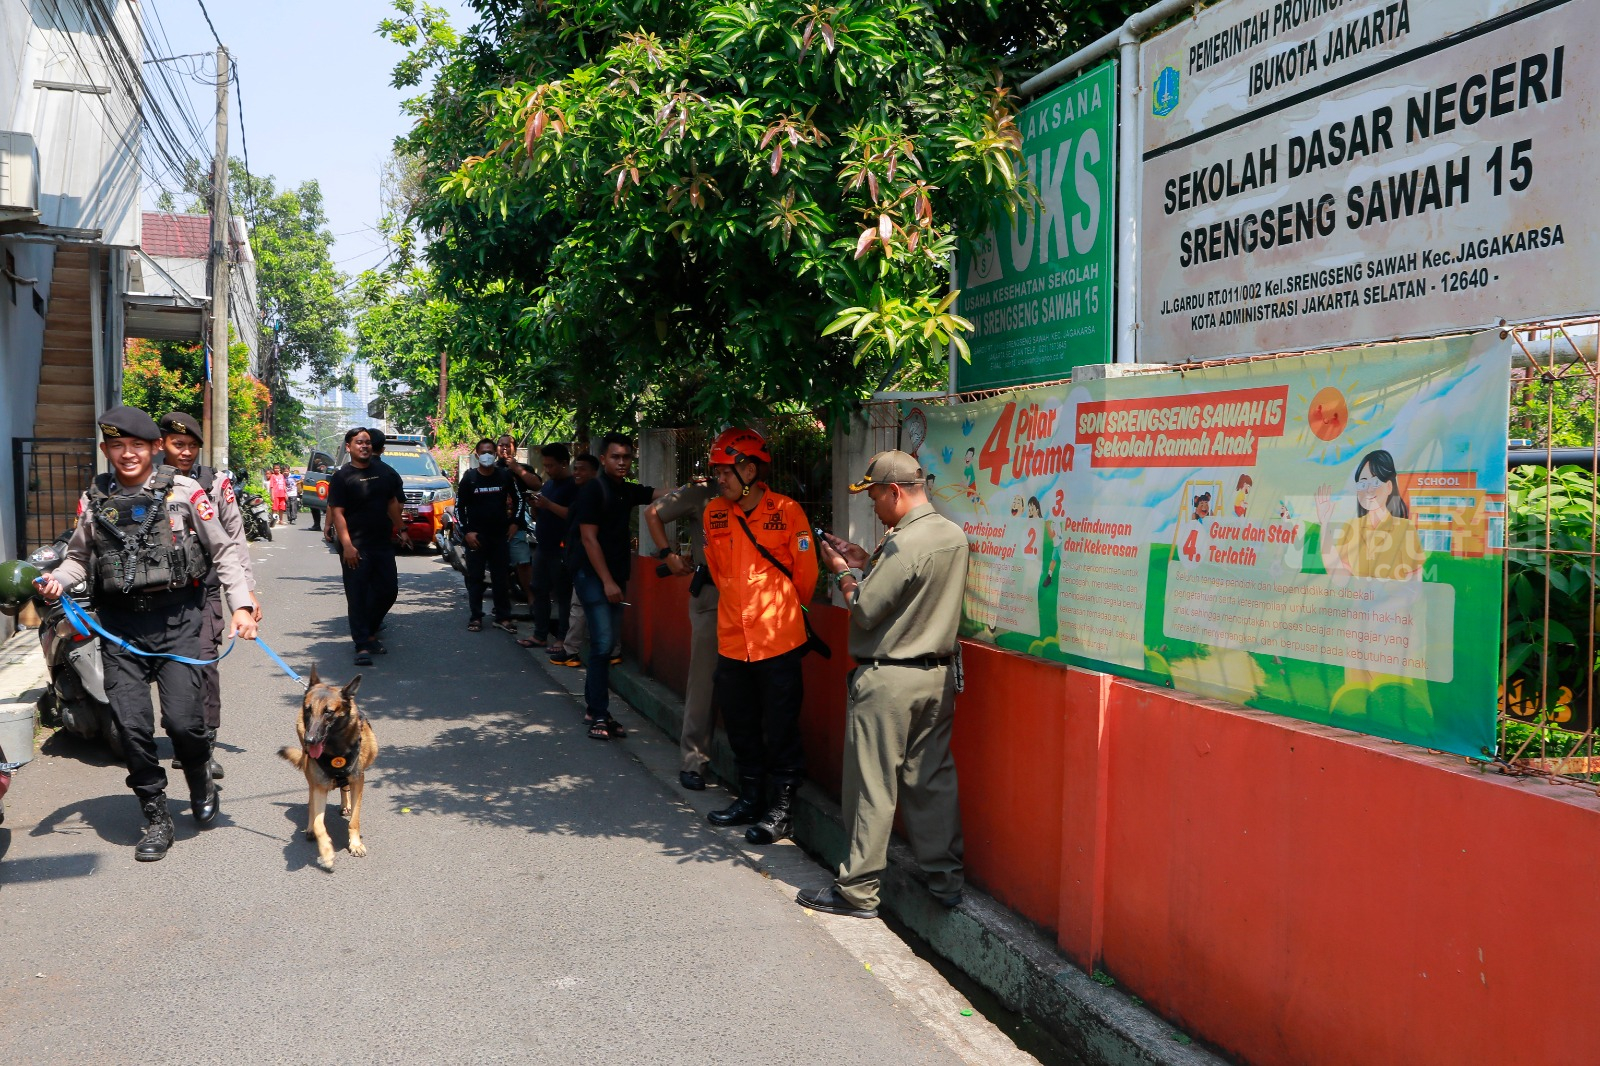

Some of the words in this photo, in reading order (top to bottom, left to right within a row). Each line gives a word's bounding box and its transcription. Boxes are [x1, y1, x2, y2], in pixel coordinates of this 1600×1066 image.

[1189, 9, 1269, 76] PEMERINTAH
[1249, 40, 1317, 97] IBUKOTA
[1323, 1, 1410, 67] JAKARTA
[1164, 144, 1277, 215] SEKOLAH
[1288, 106, 1393, 178] DASAR
[1406, 45, 1565, 143] NEGERI
[1179, 193, 1336, 268] SRENGSENG
[1346, 156, 1470, 230] SAWAH
[1486, 138, 1533, 197] 15
[1160, 293, 1204, 315] JL.GARDU
[1207, 283, 1261, 307] RT.011/002
[1265, 263, 1362, 297] Kel.SRENGSENG
[1367, 252, 1417, 279] SAWAH
[1422, 224, 1564, 269] Kec.JAGAKARSA
[964, 292, 990, 312] USAHA
[993, 277, 1045, 303] KESEHATAN
[1048, 262, 1098, 290] SEKOLAH
[1191, 313, 1216, 331] KOTA
[1219, 300, 1298, 326] ADMINISTRASI
[1301, 289, 1359, 315] JAKARTA
[1363, 278, 1426, 305] SELATAN
[1441, 267, 1489, 292] 12640
[983, 299, 1038, 336] SRENGSENG
[1042, 290, 1080, 323] SAWAH
[1085, 285, 1098, 314] 15
[1014, 403, 1056, 444] Pilar
[1079, 412, 1106, 435] SDN
[1107, 406, 1200, 433] SRENGSENG
[1201, 400, 1265, 429] SAWAH
[1265, 398, 1283, 425] 15
[979, 402, 1016, 486] 4
[1094, 433, 1153, 458] Sekolah
[1154, 431, 1210, 457] Ramah
[1211, 429, 1256, 456] Anak
[1012, 442, 1075, 479] Utama
[1417, 477, 1460, 487] SCHOOL
[1052, 489, 1065, 517] 3.
[963, 521, 1006, 539] Partisipasi
[1024, 527, 1038, 555] 2.
[1065, 517, 1132, 539] Perlindungan
[1209, 521, 1240, 540] Guru
[1242, 523, 1265, 542] dan
[1268, 524, 1299, 544] Staf
[981, 541, 1016, 560] Dihargai
[1064, 537, 1084, 552] dari
[1084, 538, 1138, 558] Kekerasan
[1182, 530, 1201, 562] 4.
[1209, 545, 1257, 566] Terlatih
[1258, 581, 1271, 591] dan
[1274, 582, 1335, 597] kependidikan
[1338, 588, 1374, 601] dibekali
[1289, 603, 1316, 615] untuk
[1319, 606, 1370, 620] memahami
[1372, 610, 1413, 626] hak-hak
[1272, 620, 1303, 632] proses
[1305, 622, 1334, 637] belajar
[1337, 627, 1381, 643] mengajar
[1384, 632, 1409, 648] yang
[1261, 636, 1277, 647] dan
[1280, 637, 1318, 653] berpusat
[1321, 645, 1343, 657] pada
[1346, 646, 1399, 665] kebutuhan
[1401, 657, 1429, 670] anak.
